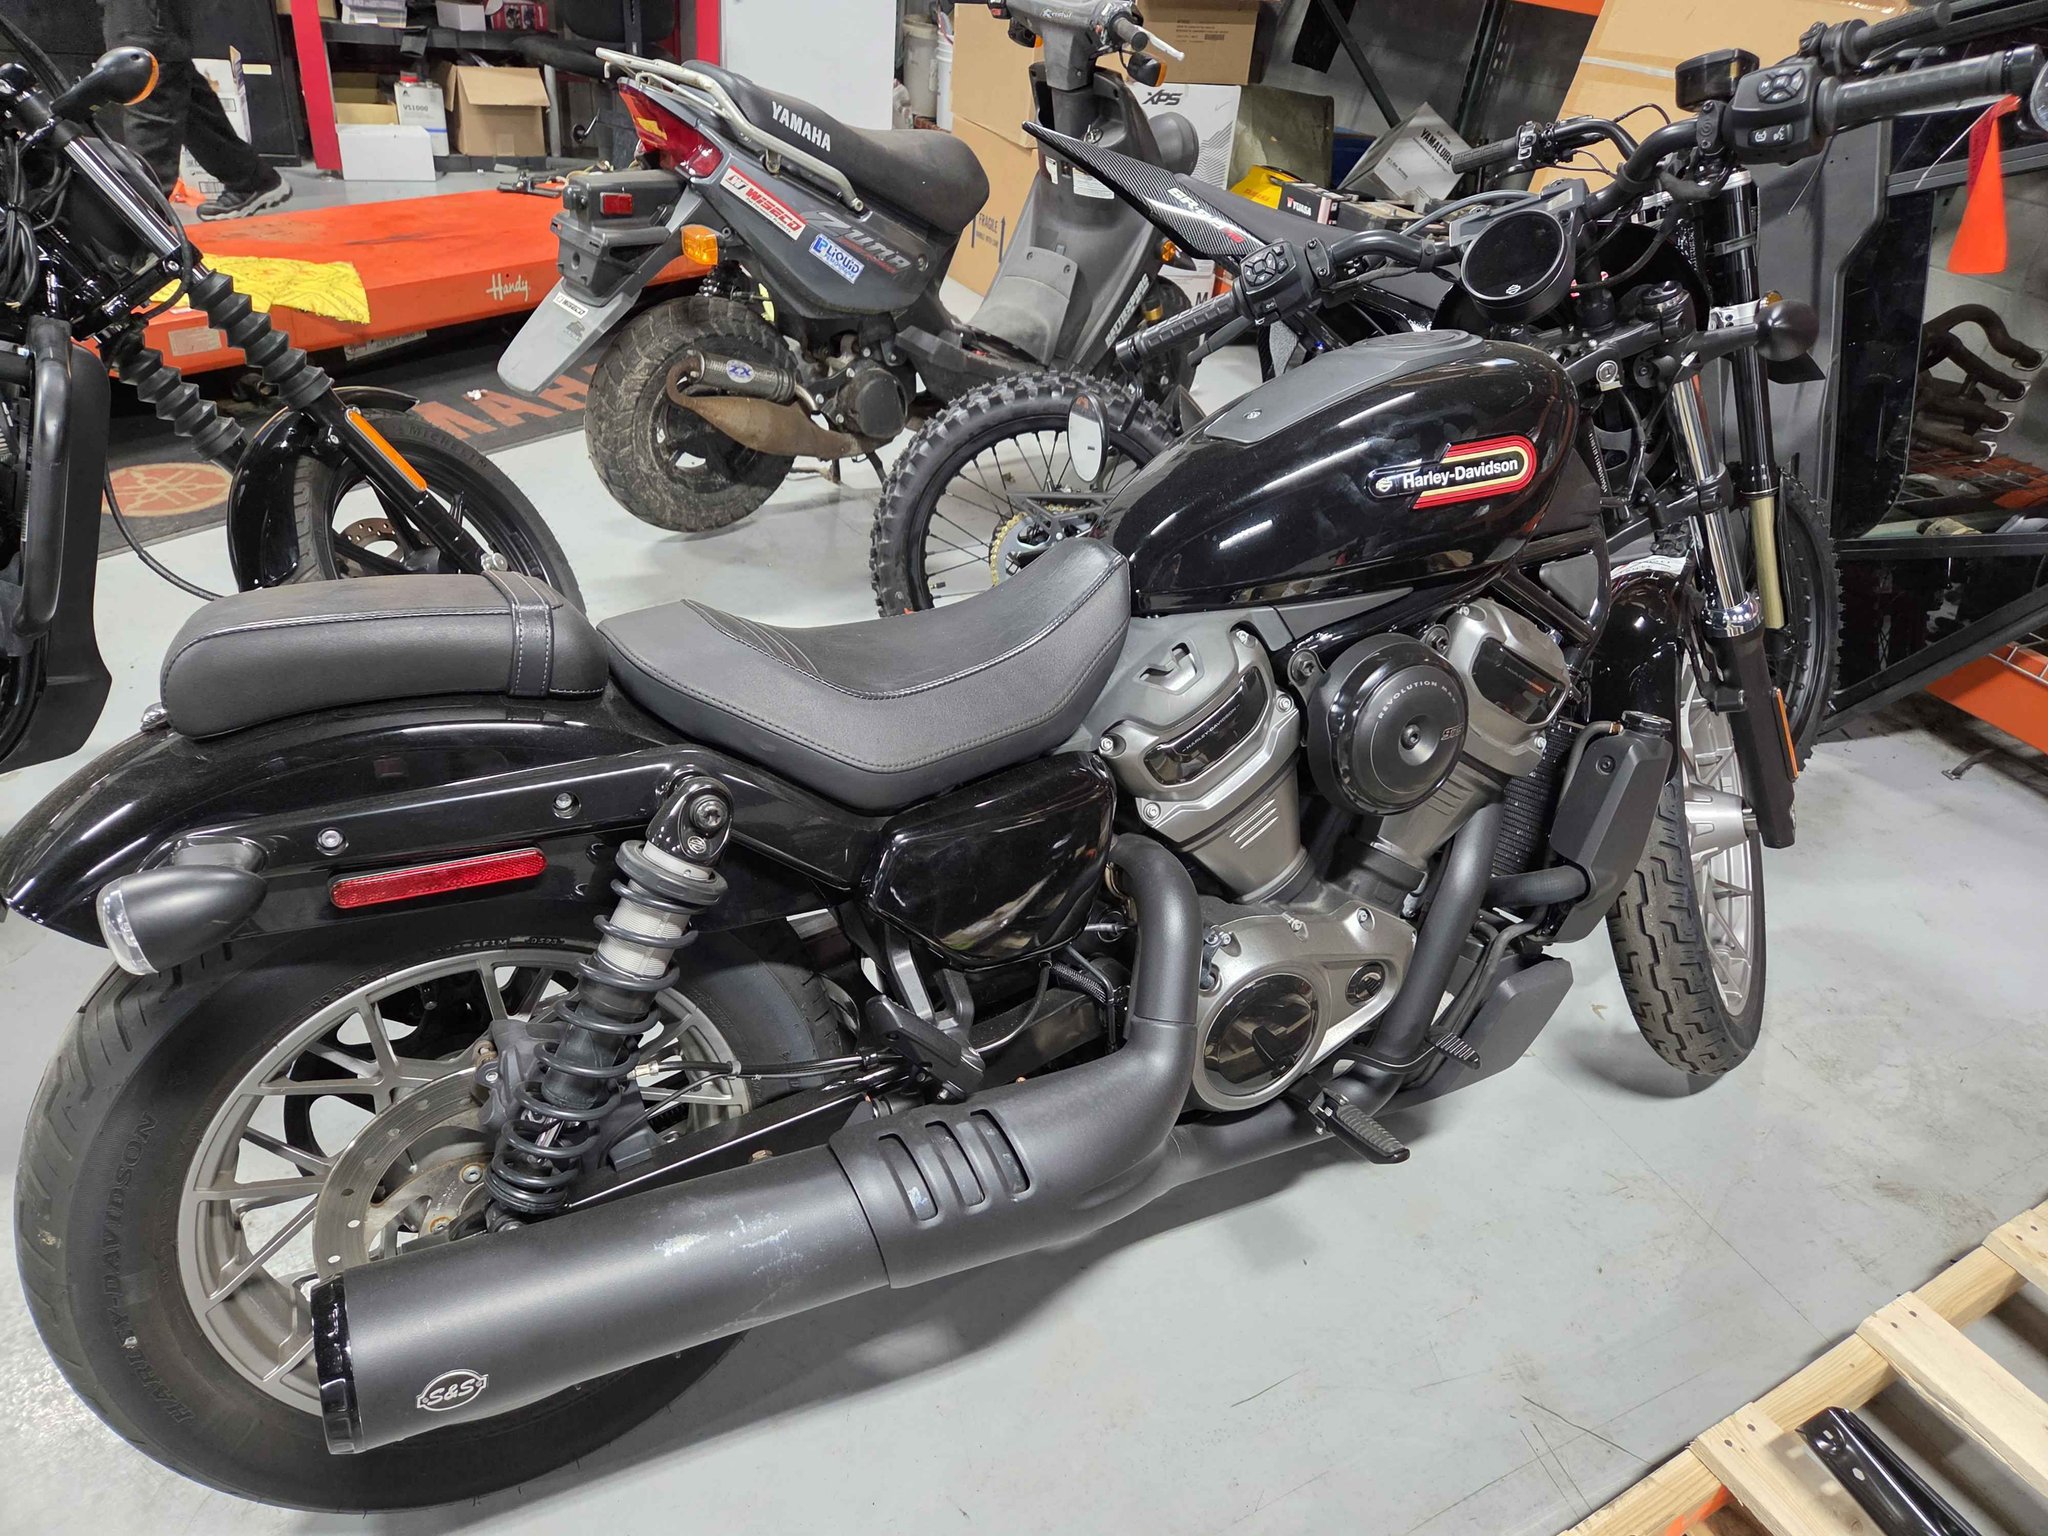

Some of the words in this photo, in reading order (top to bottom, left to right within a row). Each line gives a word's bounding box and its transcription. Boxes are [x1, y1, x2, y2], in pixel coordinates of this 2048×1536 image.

[1142, 89, 1183, 106] XPS
[772, 101, 831, 152] YAMAHA
[486, 273, 529, 302] Handy
[1402, 458, 1519, 490] Harley-Davidson
[1377, 680, 1439, 719] REVOLUTION
[426, 1378, 476, 1406] S&S
